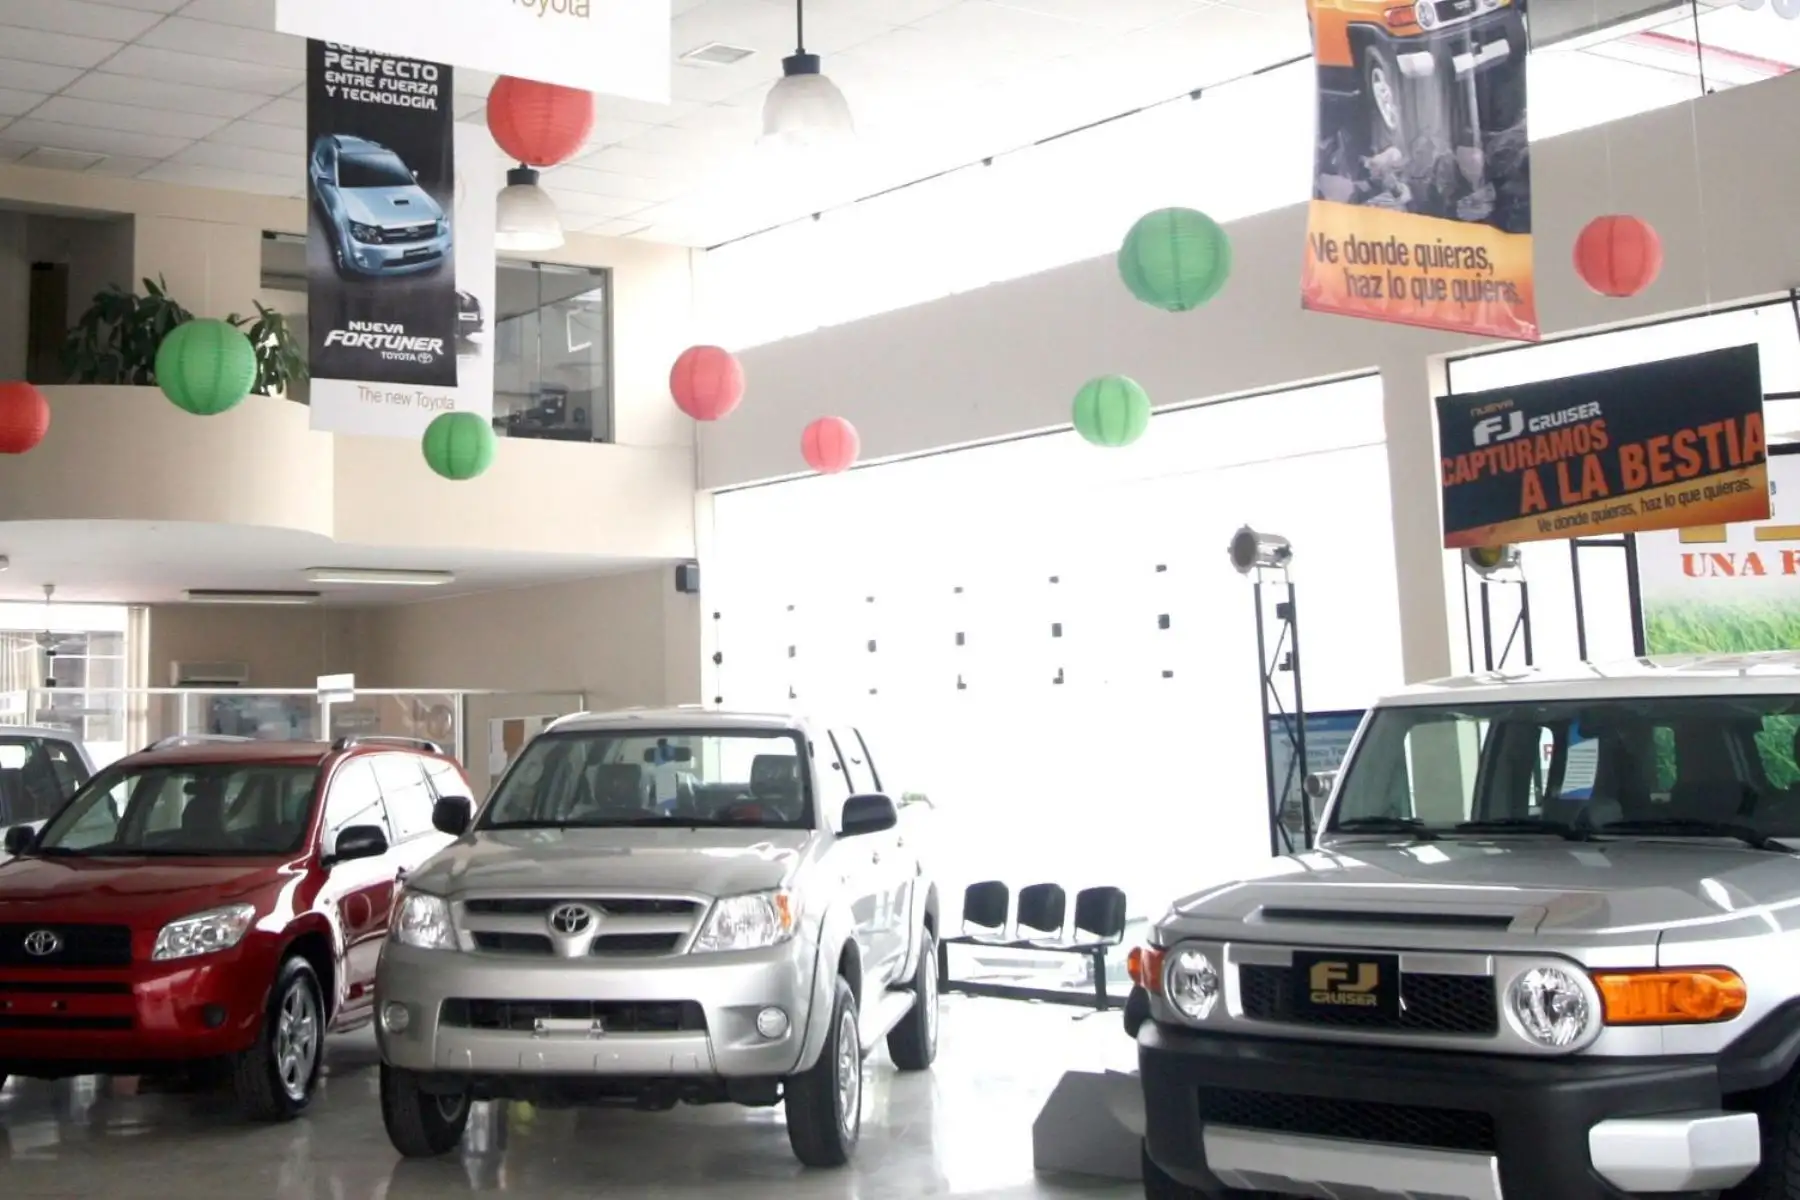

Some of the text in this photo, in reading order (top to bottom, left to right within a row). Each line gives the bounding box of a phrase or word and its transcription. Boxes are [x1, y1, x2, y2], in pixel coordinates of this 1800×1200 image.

[324, 51, 439, 82] PERFECTO
[324, 70, 439, 96] ENTRE FUERZA
[324, 84, 439, 111] Y TECNOLOGÍA.
[1310, 232, 1495, 276] Ve donde quieras,
[1343, 266, 1383, 299] haz
[1387, 269, 1407, 300] lo
[1411, 278, 1448, 306] que
[348, 321, 404, 334] NUEVA
[324, 330, 444, 355] FORTUNER
[381, 351, 417, 362] TOYOTA
[357, 385, 455, 411] The new Toyota
[1472, 401, 1603, 447] FJ CRUISER
[1441, 419, 1609, 487] CAPTURAMOS
[1520, 411, 1766, 514] A LA BESTIA
[1537, 517, 1552, 533] Ve
[1554, 511, 1589, 531] donde
[1591, 502, 1636, 525] quieras,
[1640, 496, 1661, 514] haz
[1664, 492, 1676, 508] lo
[1678, 489, 1701, 507] que
[1703, 476, 1754, 501] quieras.
[1680, 551, 1768, 578] UNA
[1310, 962, 1378, 992] FJ
[1310, 991, 1378, 1006] CRUISER
